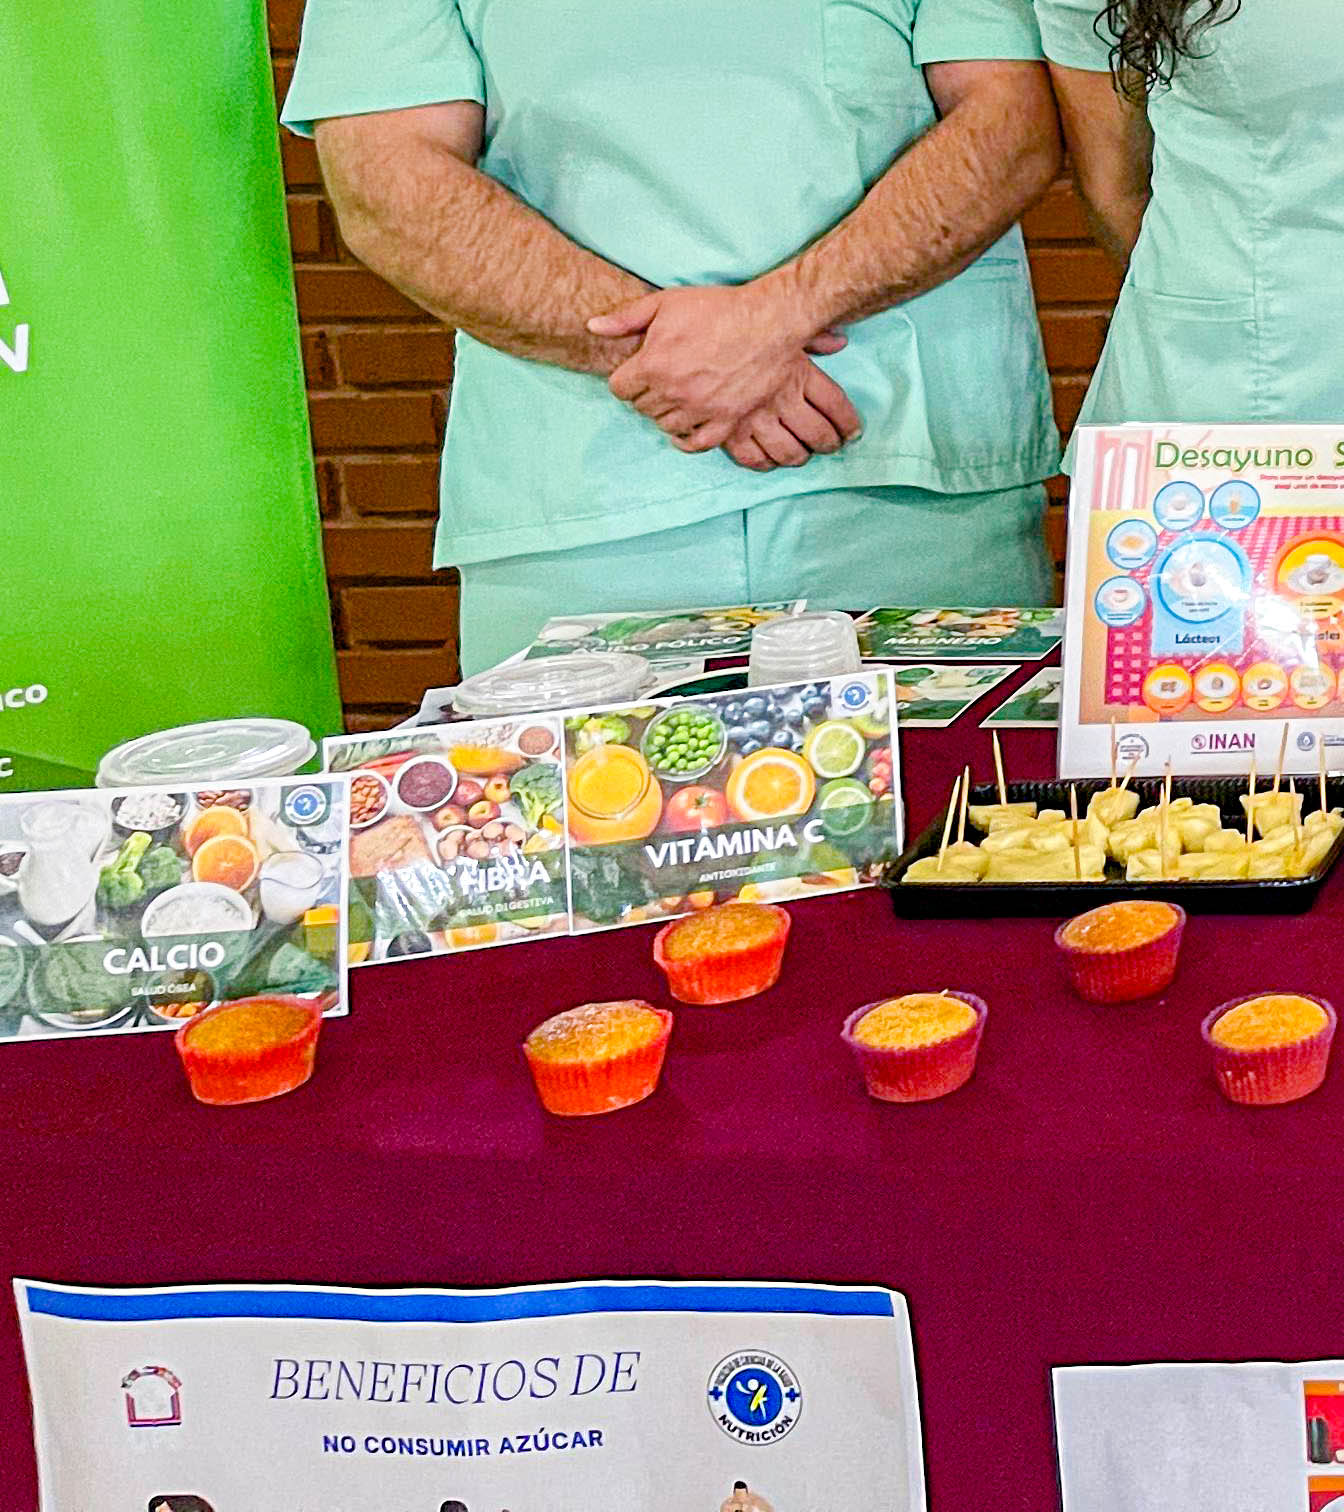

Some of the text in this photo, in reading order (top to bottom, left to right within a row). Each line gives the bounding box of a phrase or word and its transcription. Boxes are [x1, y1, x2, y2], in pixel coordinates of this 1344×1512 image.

[1154, 441, 1314, 472] Desayuno
[1208, 733, 1256, 750] INAN
[645, 818, 825, 868] VITAMINA C
[102, 941, 225, 975] CALCIO
[131, 983, 166, 997] SALUD
[269, 1351, 642, 1405] BENEFICIOS DE
[322, 1427, 604, 1457] NO CONSUMIR AZÚCAR
